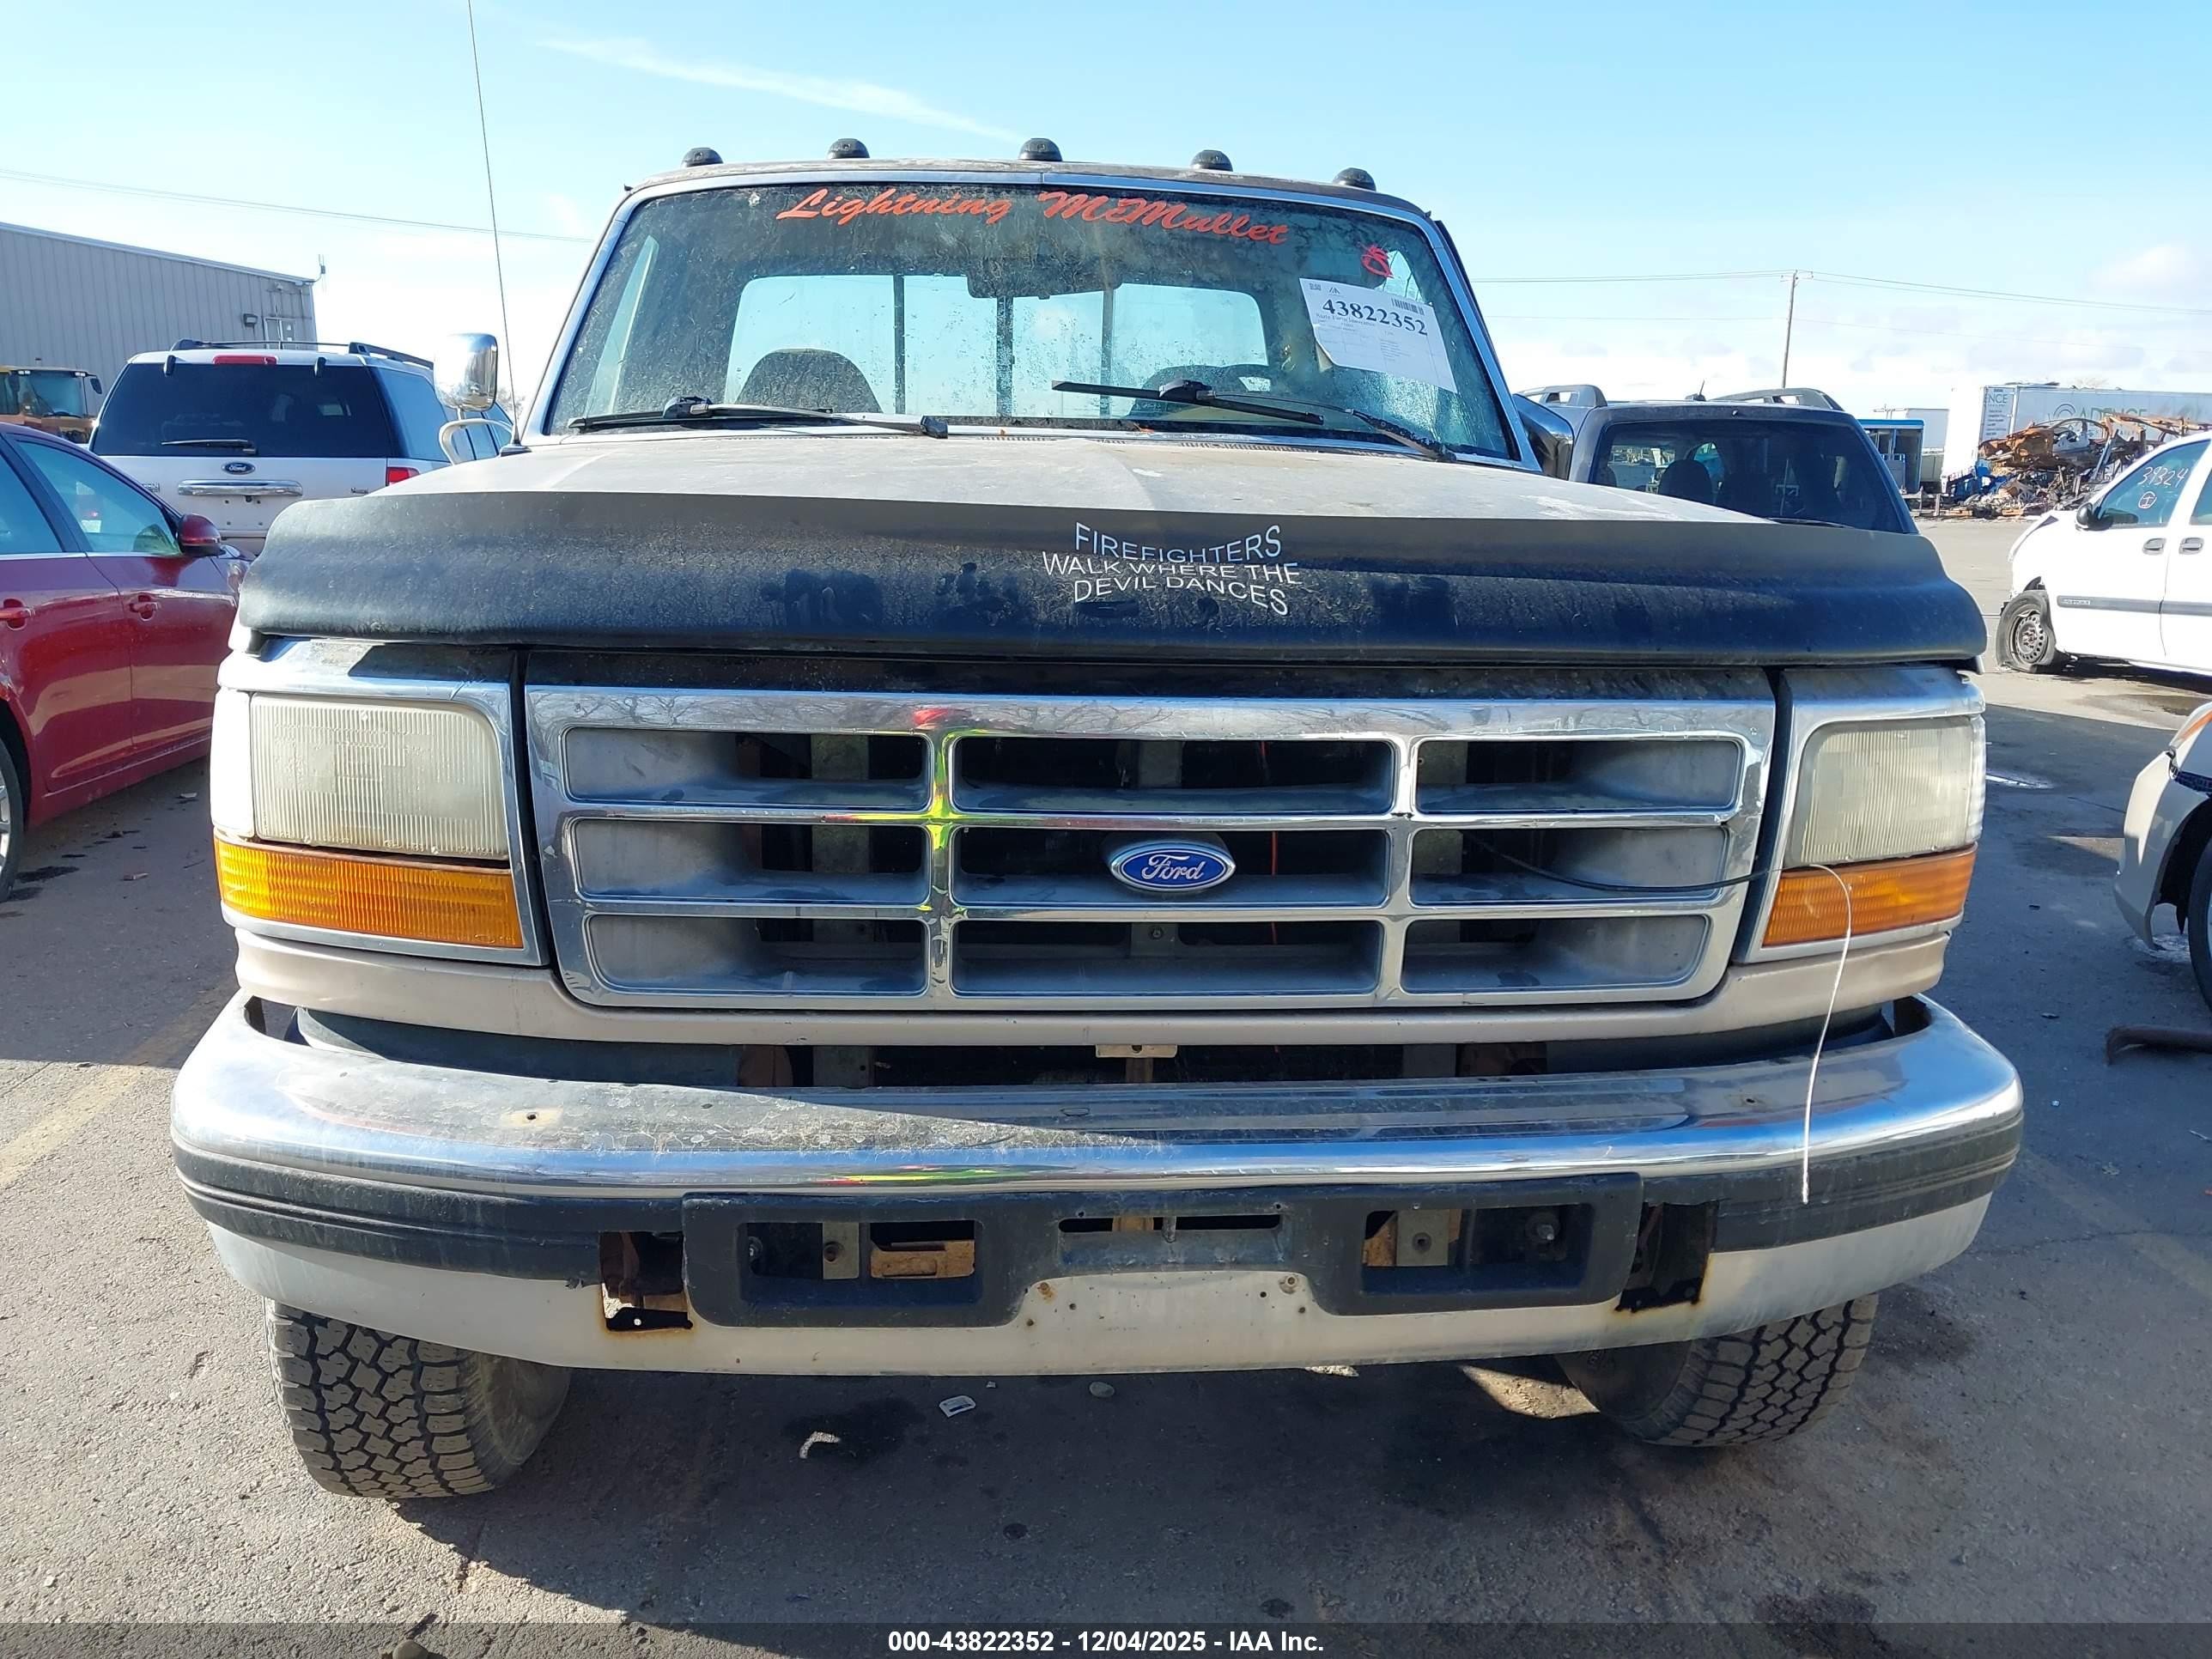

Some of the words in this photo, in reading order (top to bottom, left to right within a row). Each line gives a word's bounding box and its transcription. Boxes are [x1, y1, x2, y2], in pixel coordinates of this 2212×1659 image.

[775, 188, 1012, 225] Lightning
[1322, 299, 1428, 336] 43822352
[1076, 522, 1281, 563] FIREFIGHTERS
[1042, 550, 1121, 575] WALK
[1129, 562, 1237, 578] WHERE
[1245, 562, 1302, 584] THE
[1074, 577, 1156, 603] DEVIL
[1166, 576, 1288, 615] DANCES
[1141, 854, 1206, 880] Ford
